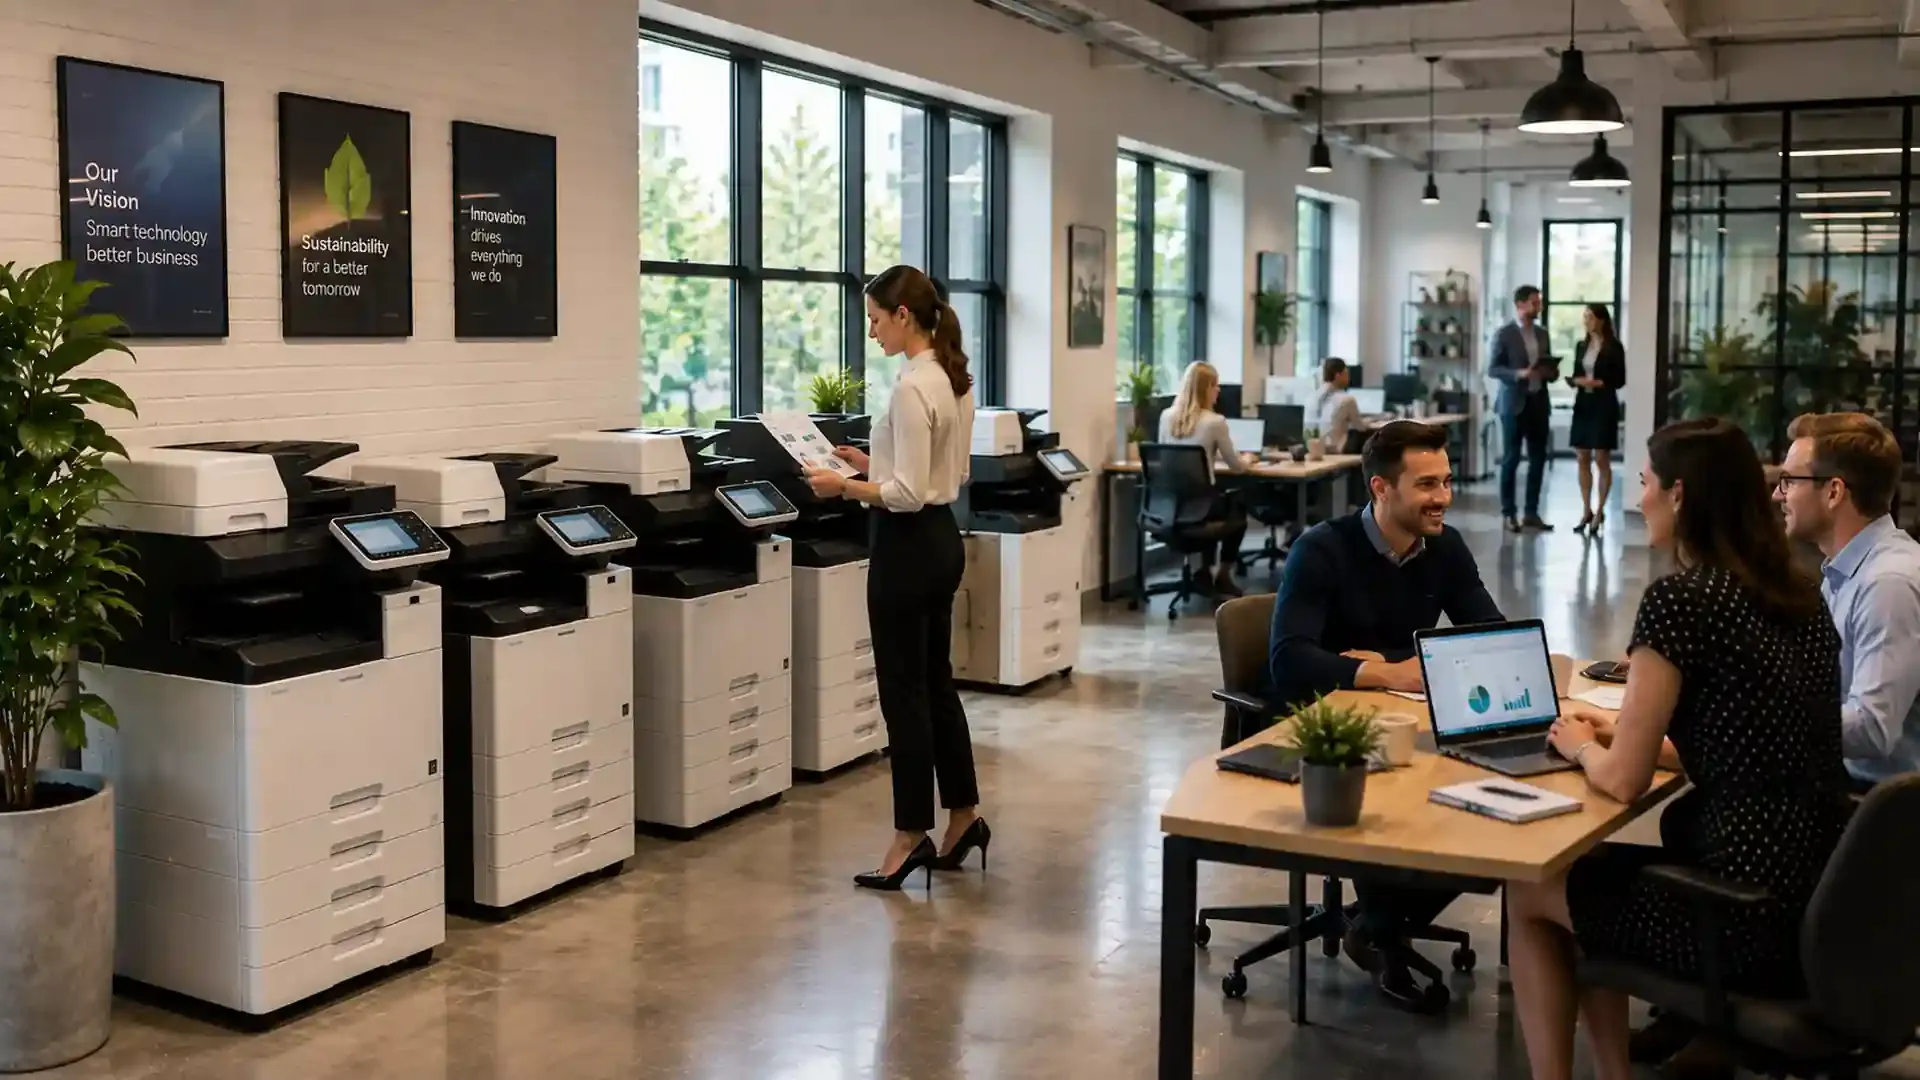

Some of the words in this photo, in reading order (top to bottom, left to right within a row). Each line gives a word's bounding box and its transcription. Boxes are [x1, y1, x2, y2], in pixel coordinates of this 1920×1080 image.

[85, 162, 119, 183] Our
[85, 188, 139, 210] Vision
[470, 204, 526, 225] Innovation
[86, 219, 131, 239] Smart
[134, 223, 208, 247] technology
[471, 228, 502, 243] drives
[86, 243, 132, 263] better
[136, 247, 199, 266] business
[302, 234, 389, 258] Sustainability
[302, 257, 320, 273] for
[322, 262, 330, 273] a
[333, 258, 369, 275] better
[471, 249, 523, 267] everything
[471, 270, 486, 281] we
[488, 268, 502, 282] do
[302, 281, 361, 296] tomorrow
